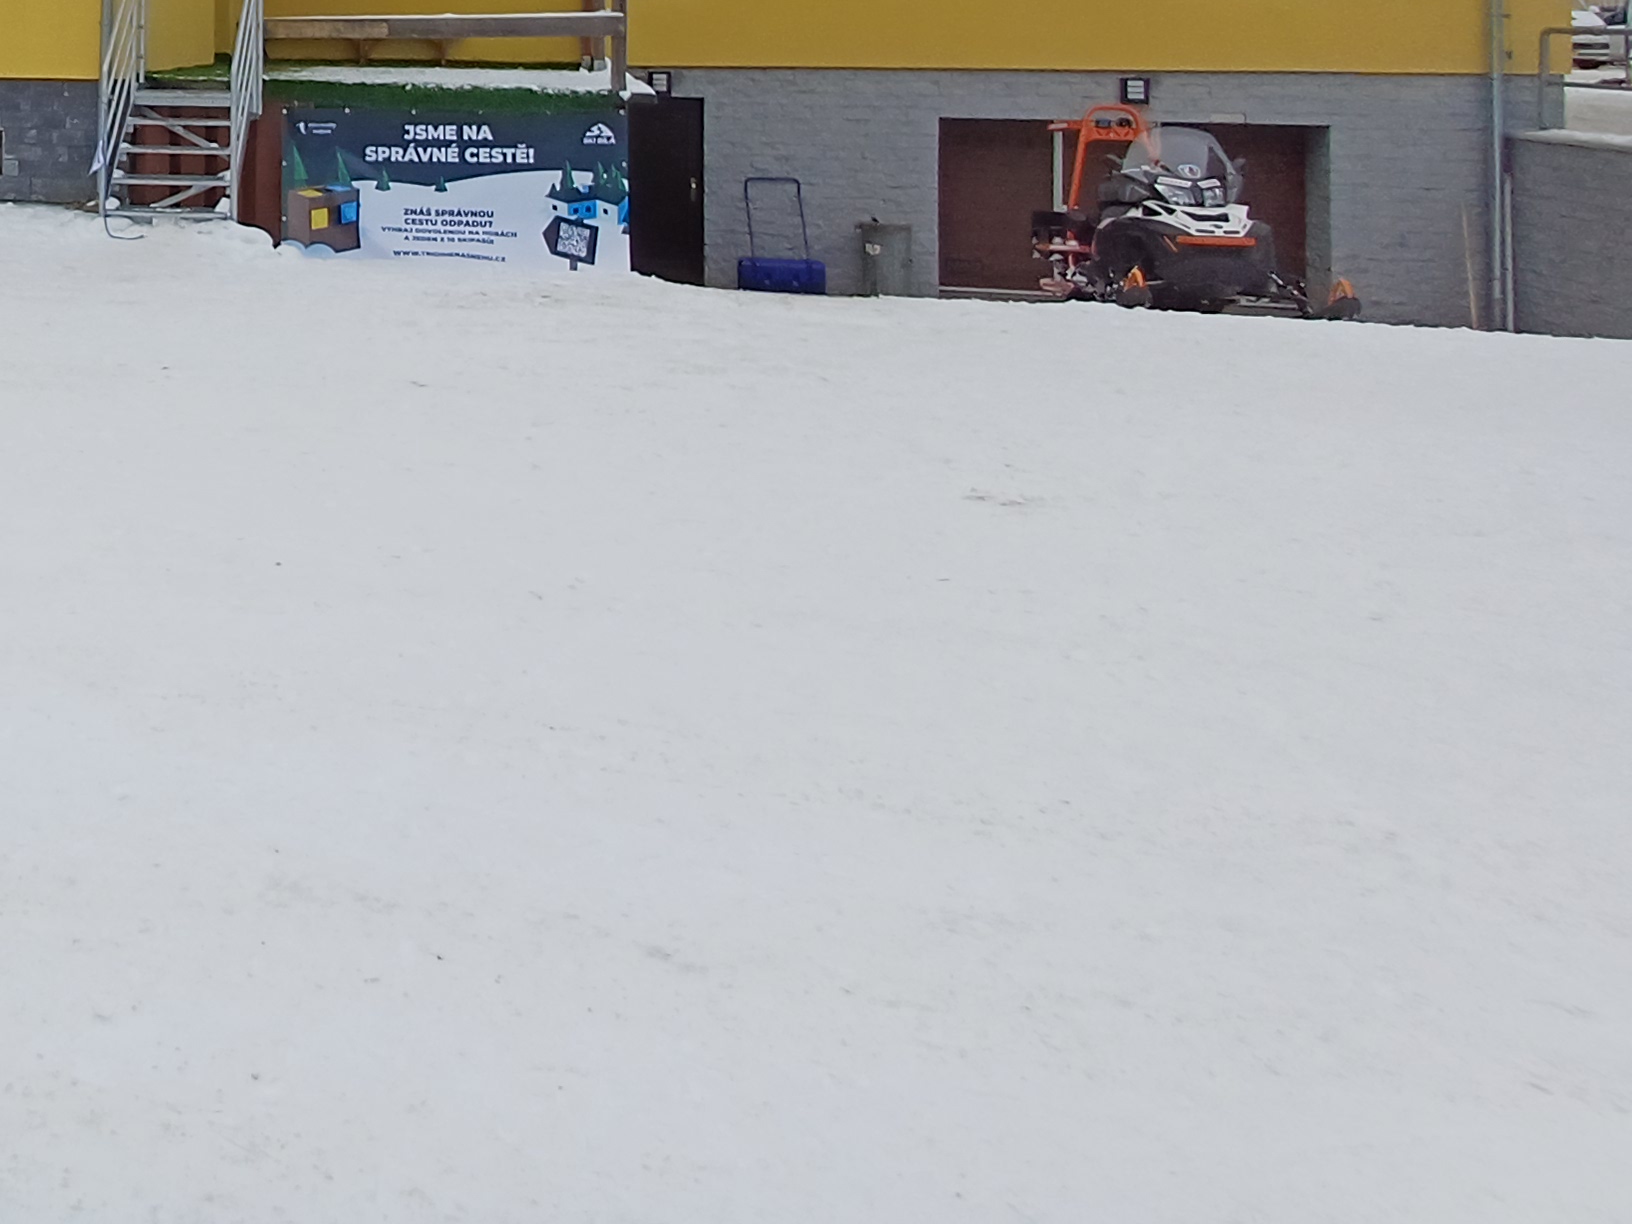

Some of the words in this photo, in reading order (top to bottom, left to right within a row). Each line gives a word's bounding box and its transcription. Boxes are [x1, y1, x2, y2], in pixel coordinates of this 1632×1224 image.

[404, 124, 457, 140] JSME
[462, 124, 494, 141] NA
[364, 143, 460, 163] SPRÁVNÉ
[464, 144, 535, 164] CESTĚ!
[403, 206, 432, 217] ZNÁŠ
[434, 207, 494, 218] SPRÁVNOU
[404, 217, 438, 226] CESTU
[440, 219, 493, 228] ODPADU?
